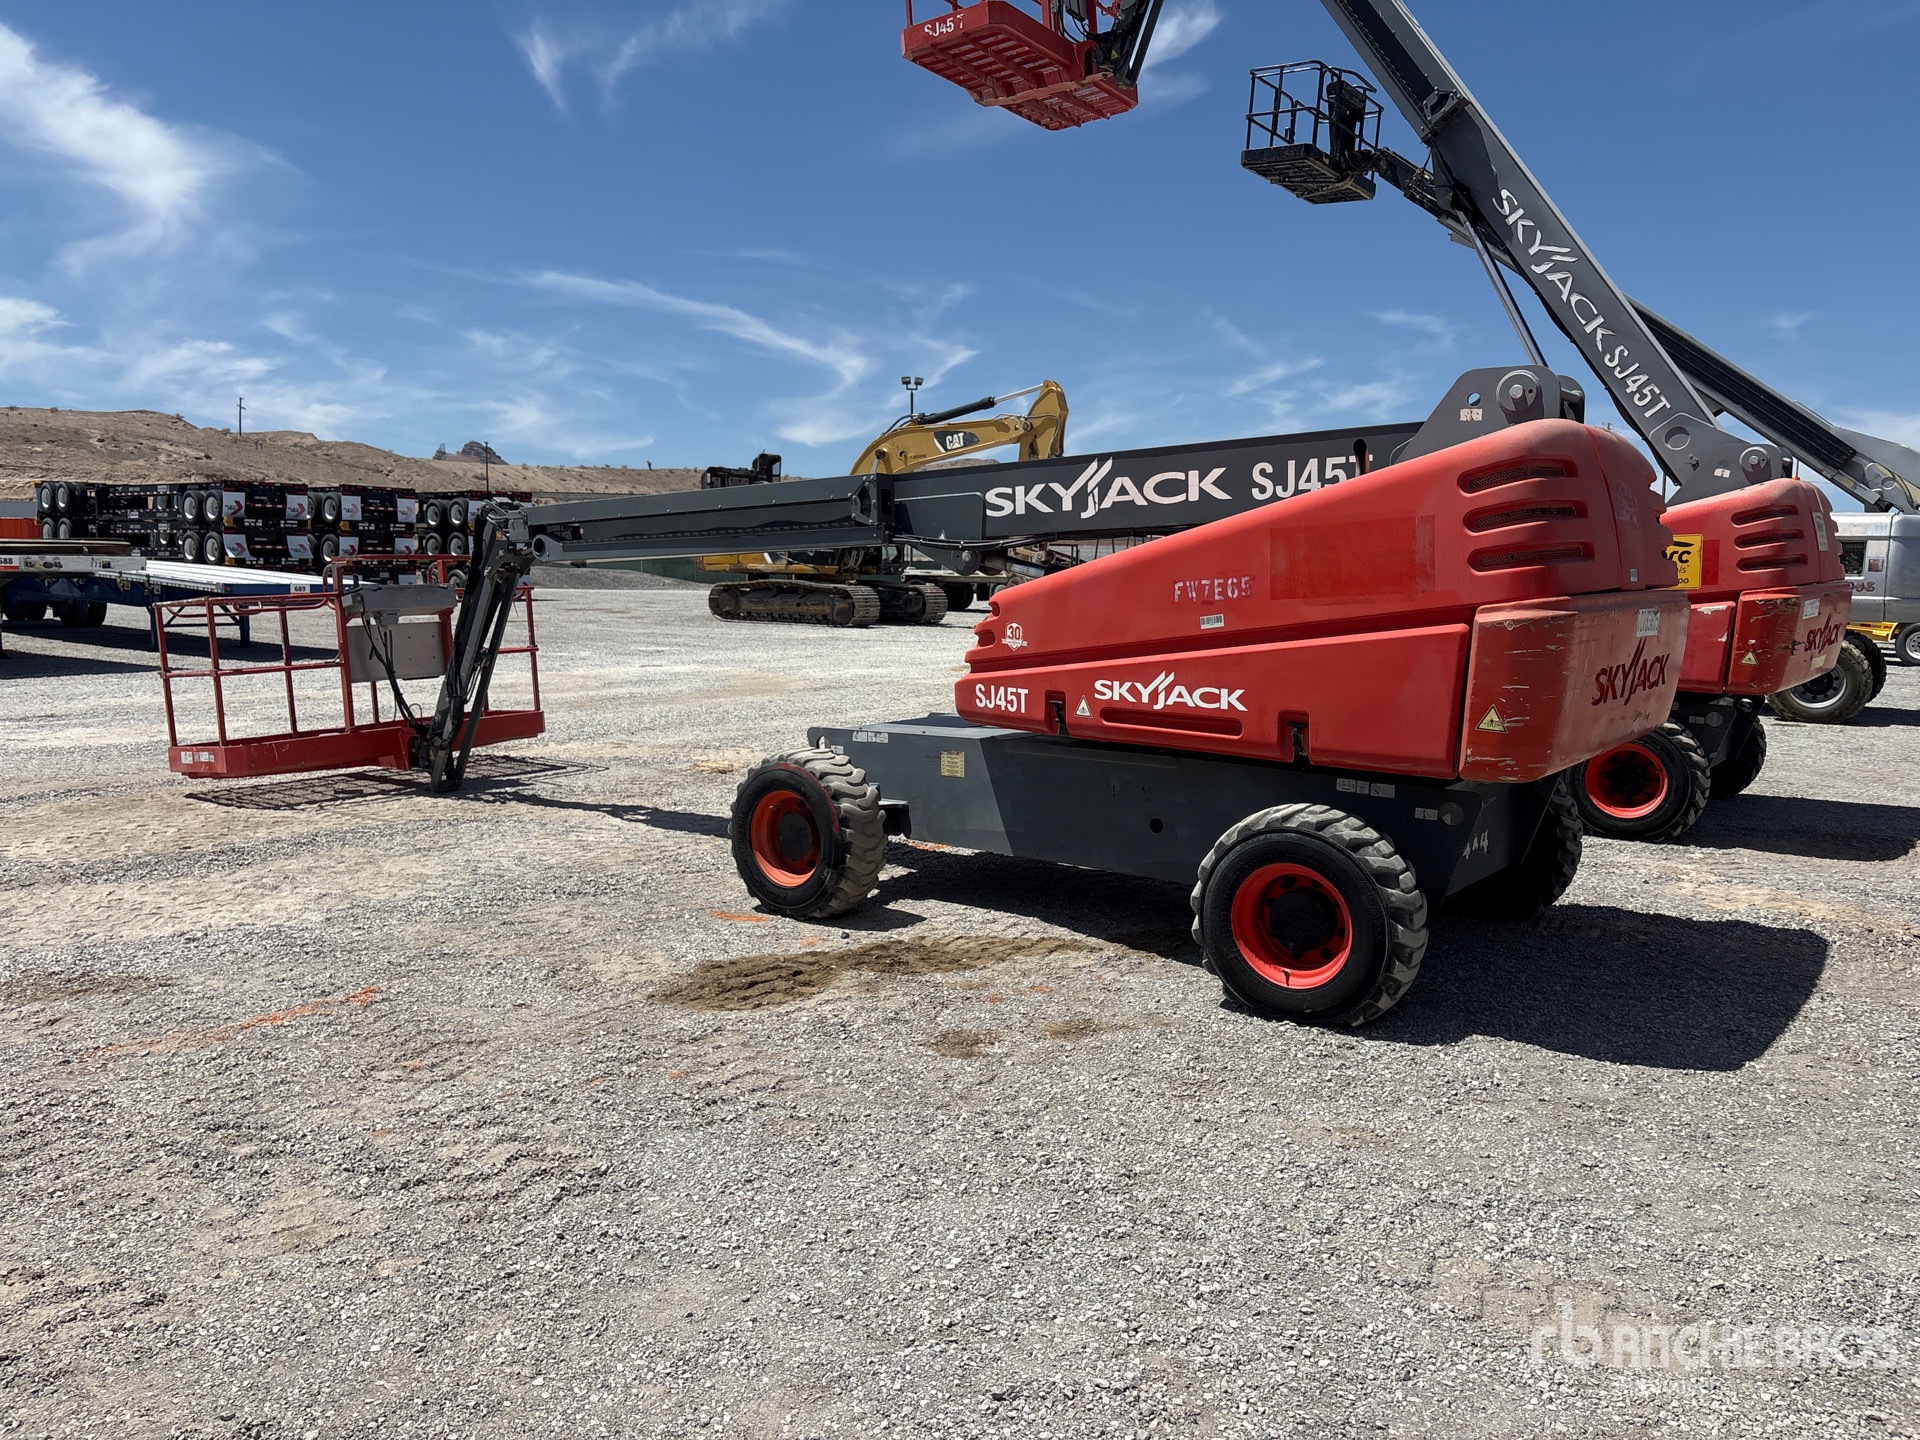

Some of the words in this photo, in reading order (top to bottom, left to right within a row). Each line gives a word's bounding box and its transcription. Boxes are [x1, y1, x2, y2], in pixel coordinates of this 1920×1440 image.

[1492, 188, 1616, 352] SKYJACK
[1604, 344, 1672, 420] SJ45T
[945, 432, 965, 450] CAT
[984, 456, 1234, 519] SKYJACK
[1174, 576, 1253, 603] FW7E65
[1007, 625, 1021, 640] 30
[1591, 635, 1671, 707] SKYJACK
[975, 683, 1029, 713] SJ45T
[1094, 670, 1249, 712] SKYJACK
